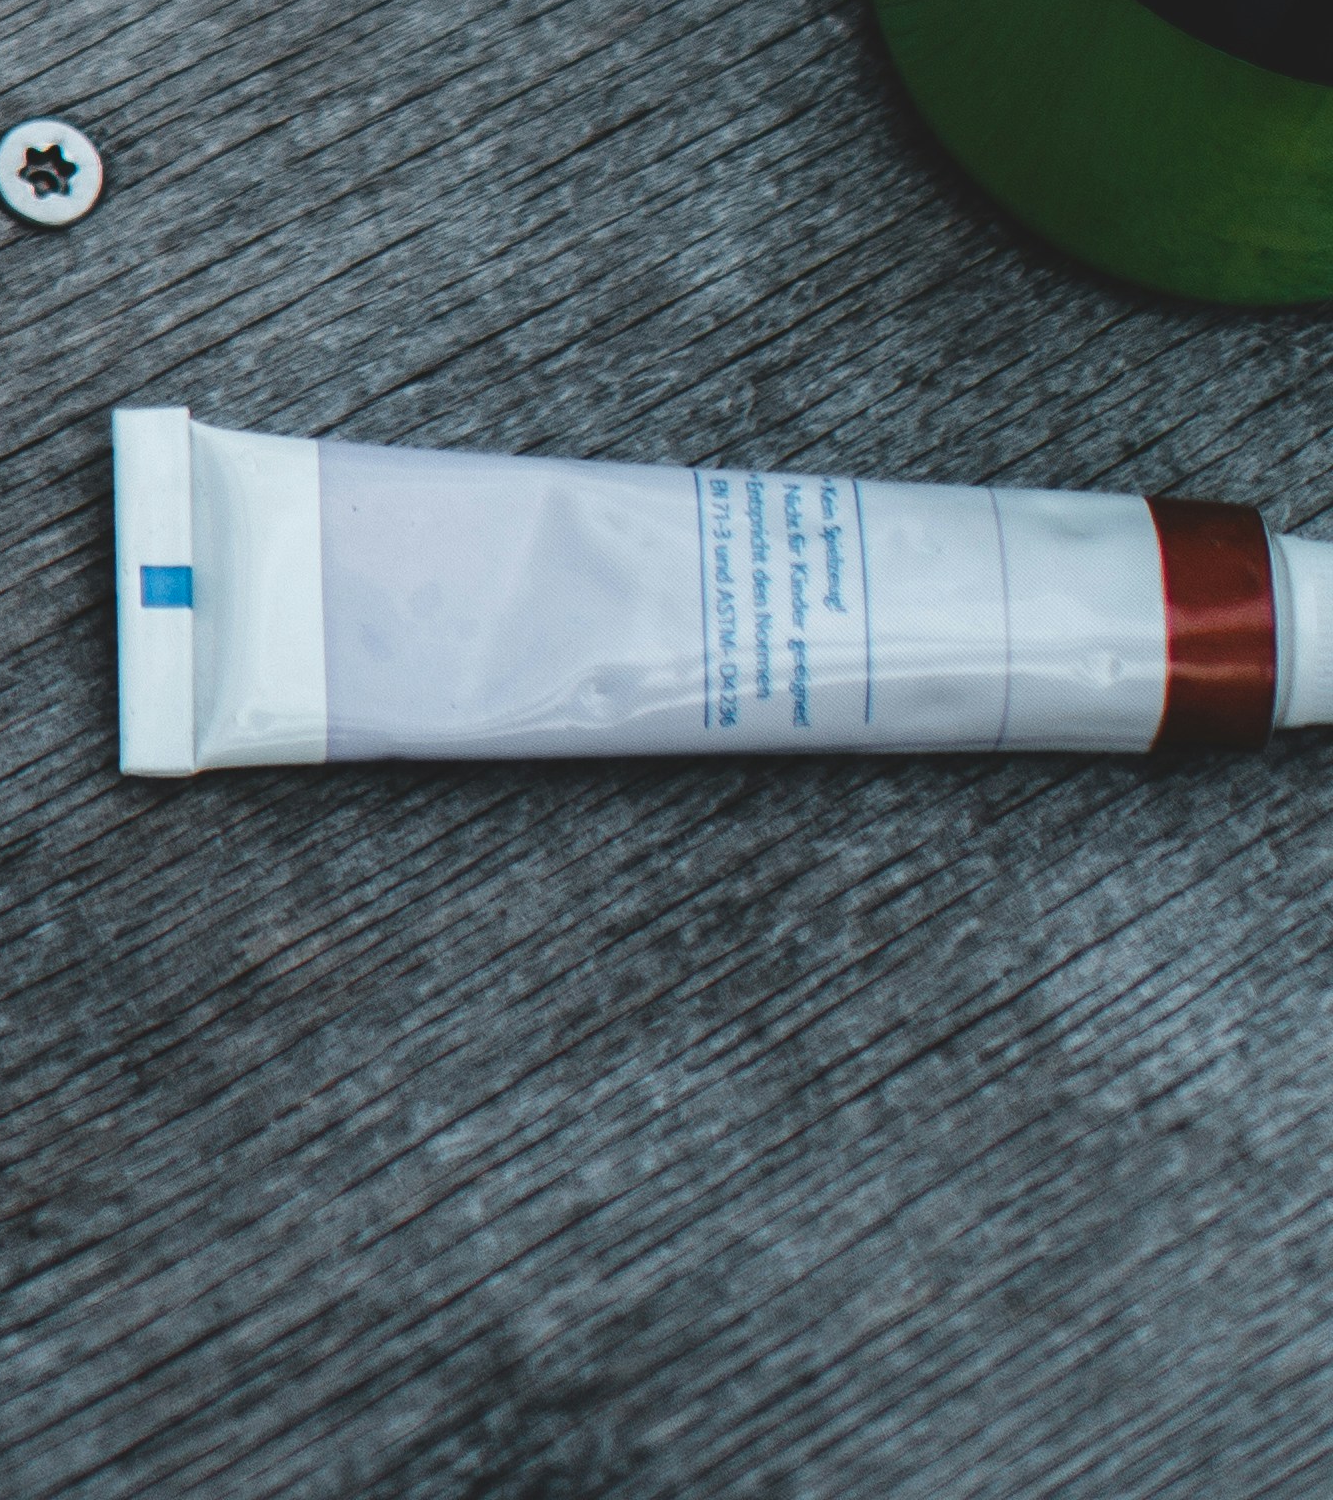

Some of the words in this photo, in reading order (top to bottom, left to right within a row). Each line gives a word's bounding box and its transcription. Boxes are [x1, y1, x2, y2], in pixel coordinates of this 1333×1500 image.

[714, 544, 734, 585] und
[790, 562, 809, 630] Kinder
[755, 611, 772, 700] Normen
